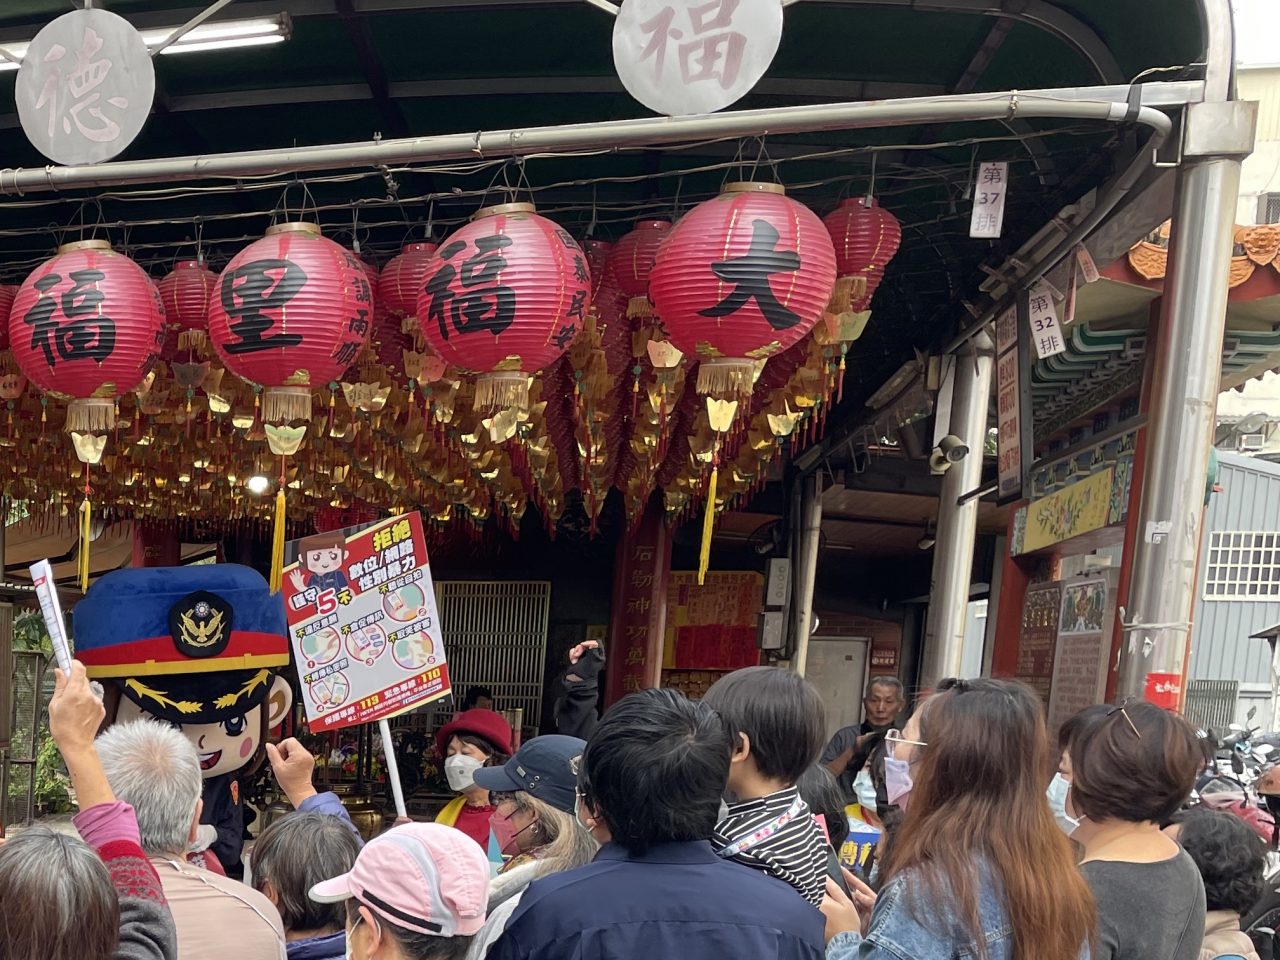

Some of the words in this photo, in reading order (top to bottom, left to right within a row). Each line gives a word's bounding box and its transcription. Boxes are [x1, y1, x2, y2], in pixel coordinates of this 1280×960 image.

[36, 27, 128, 142] 德
[24, 269, 116, 367] 福
[221, 259, 307, 354] 里
[425, 235, 516, 341] 福
[697, 218, 801, 330] 大
